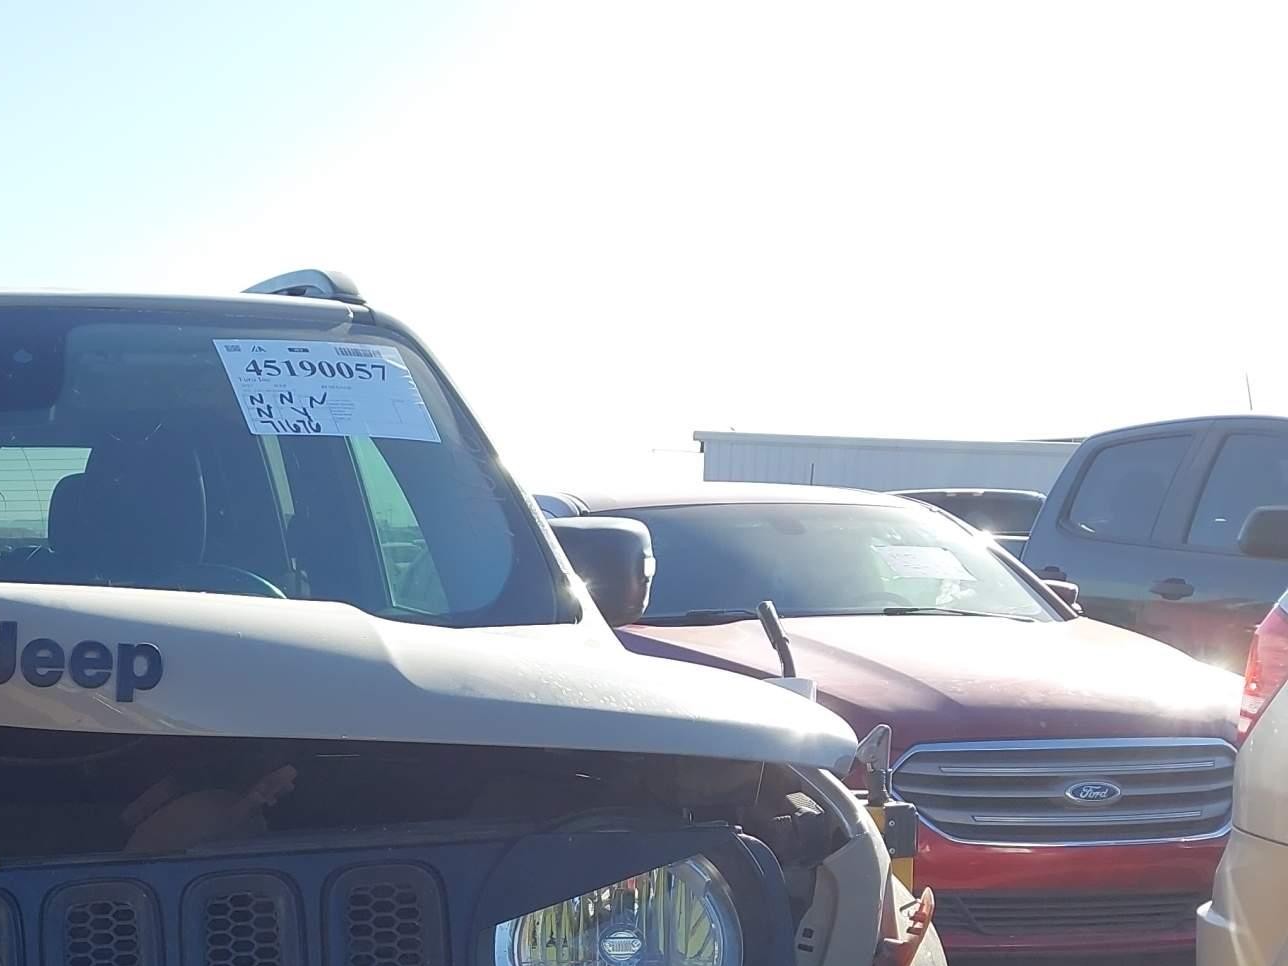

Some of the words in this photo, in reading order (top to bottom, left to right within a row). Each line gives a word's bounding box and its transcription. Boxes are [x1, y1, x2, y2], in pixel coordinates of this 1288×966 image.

[245, 359, 387, 382] 45190057
[249, 393, 264, 405] N
[279, 391, 294, 405] N
[309, 391, 328, 409] N
[256, 404, 274, 419] N
[1079, 785, 1109, 799] Ford
